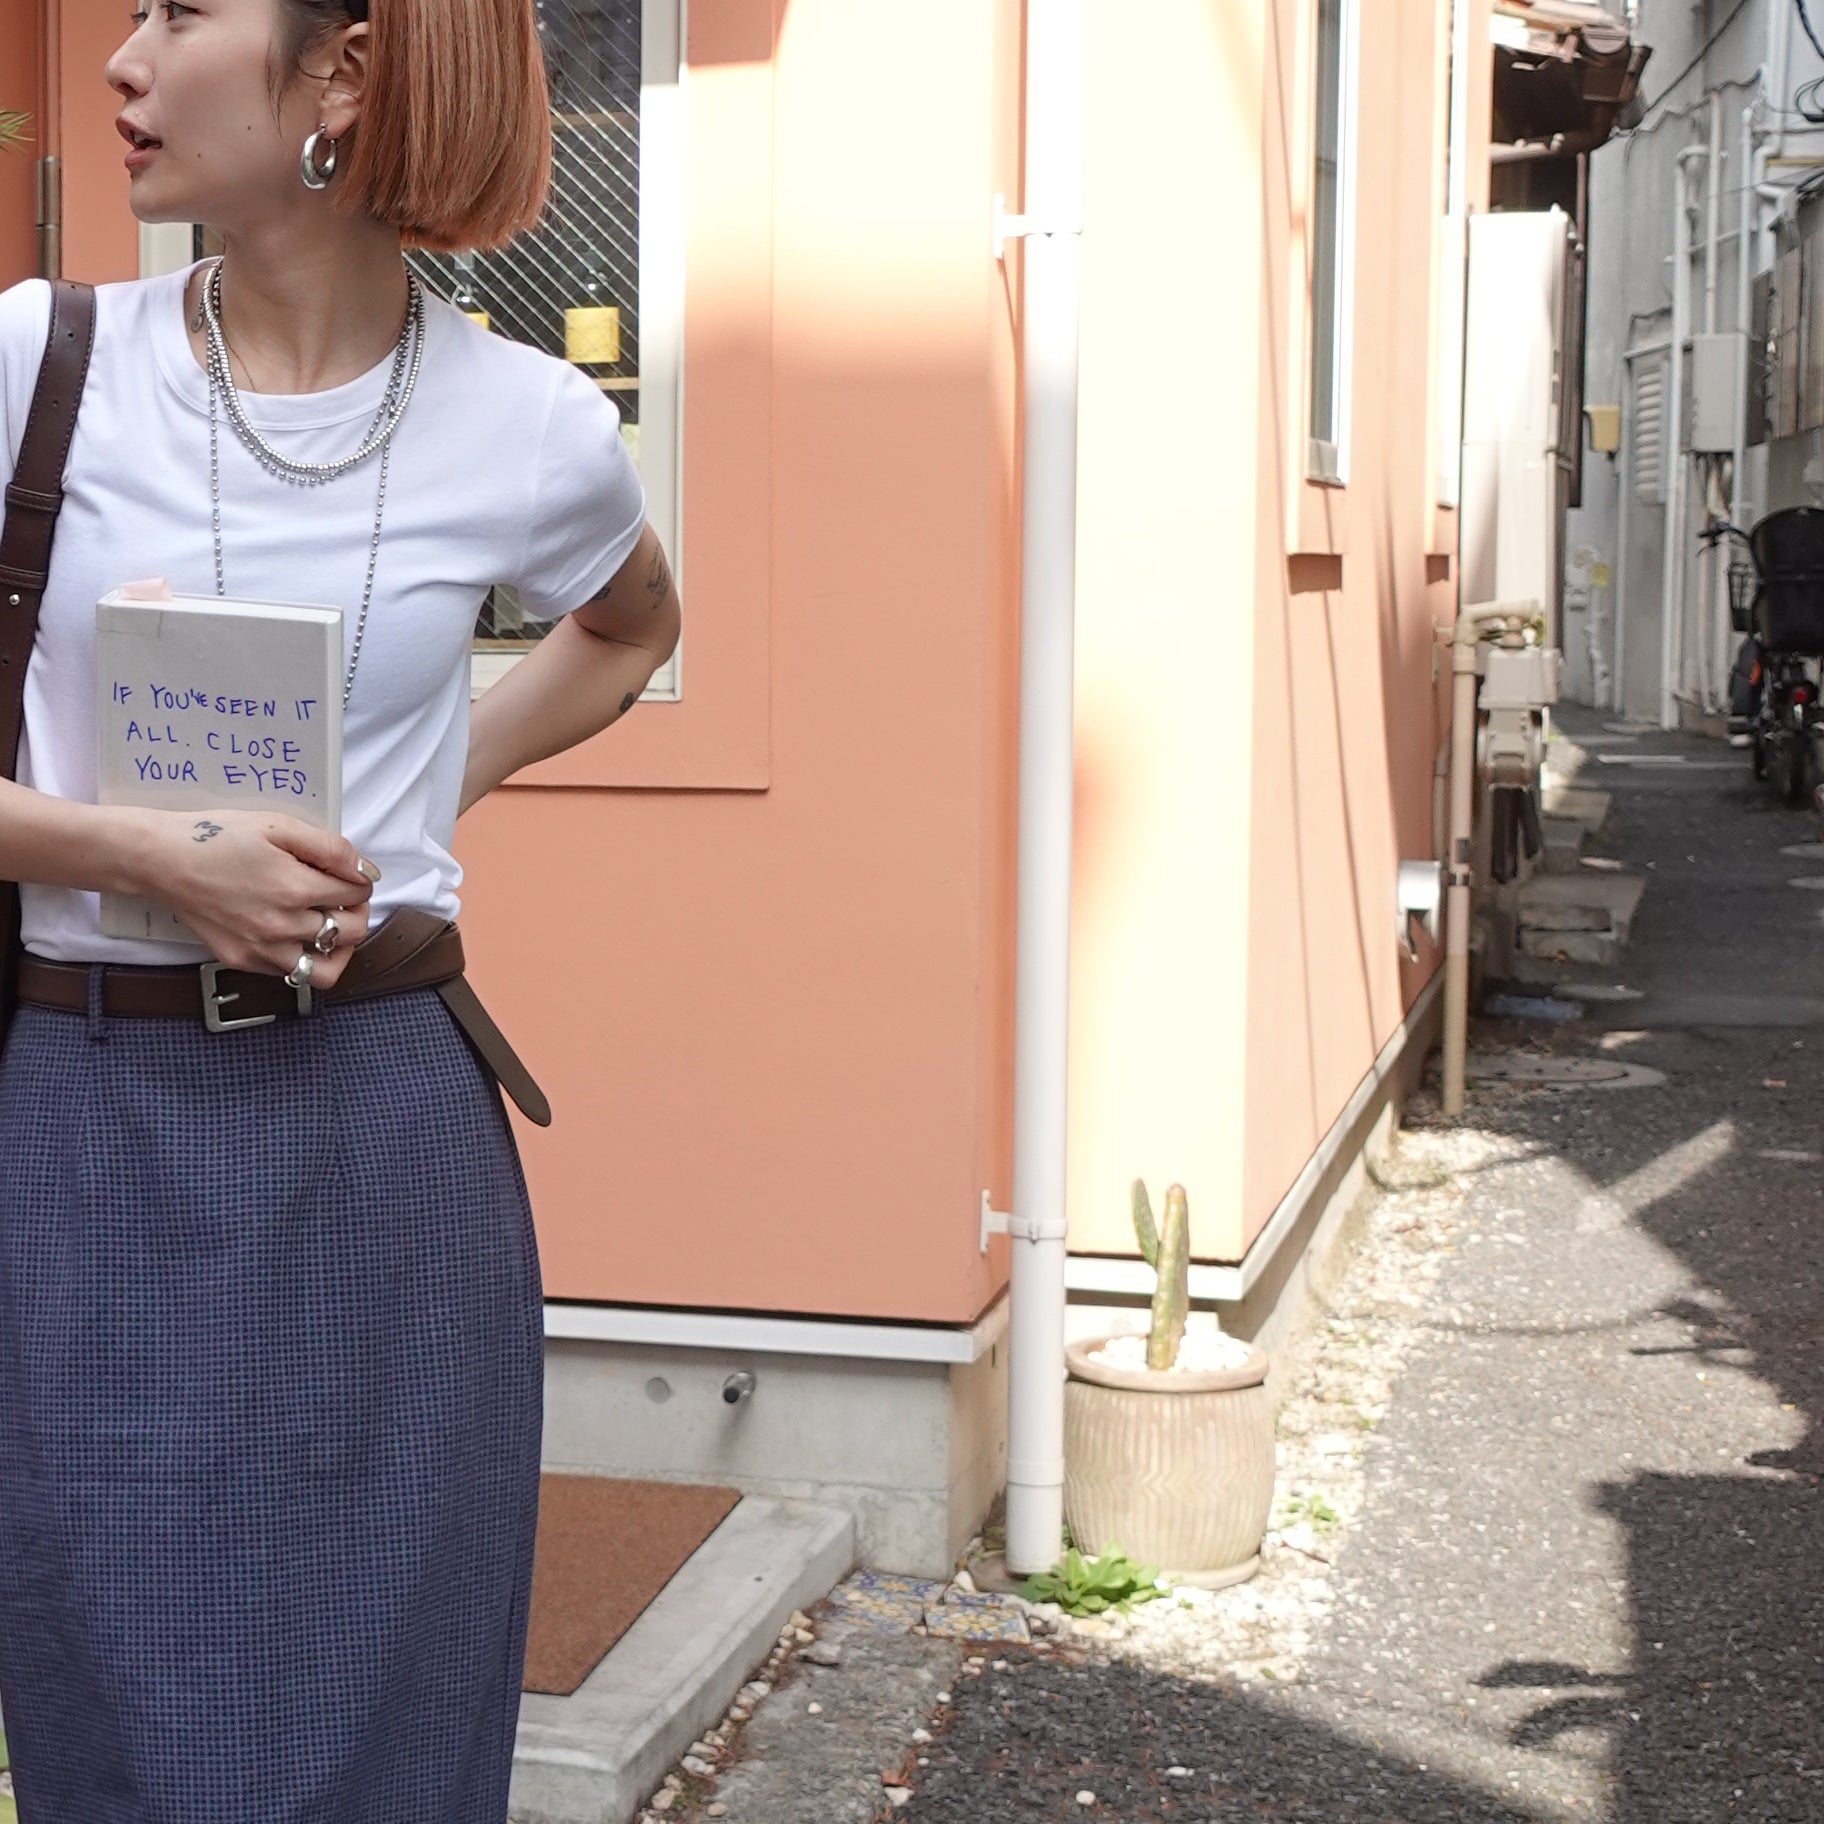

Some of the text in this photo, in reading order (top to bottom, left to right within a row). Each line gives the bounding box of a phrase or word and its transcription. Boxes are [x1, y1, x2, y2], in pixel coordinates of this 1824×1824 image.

[113, 681, 133, 705] IF
[214, 696, 276, 717] SEEN
[294, 699, 317, 721] IT
[207, 732, 301, 763] CLOSE
[134, 754, 317, 798] YOUR EYES.
